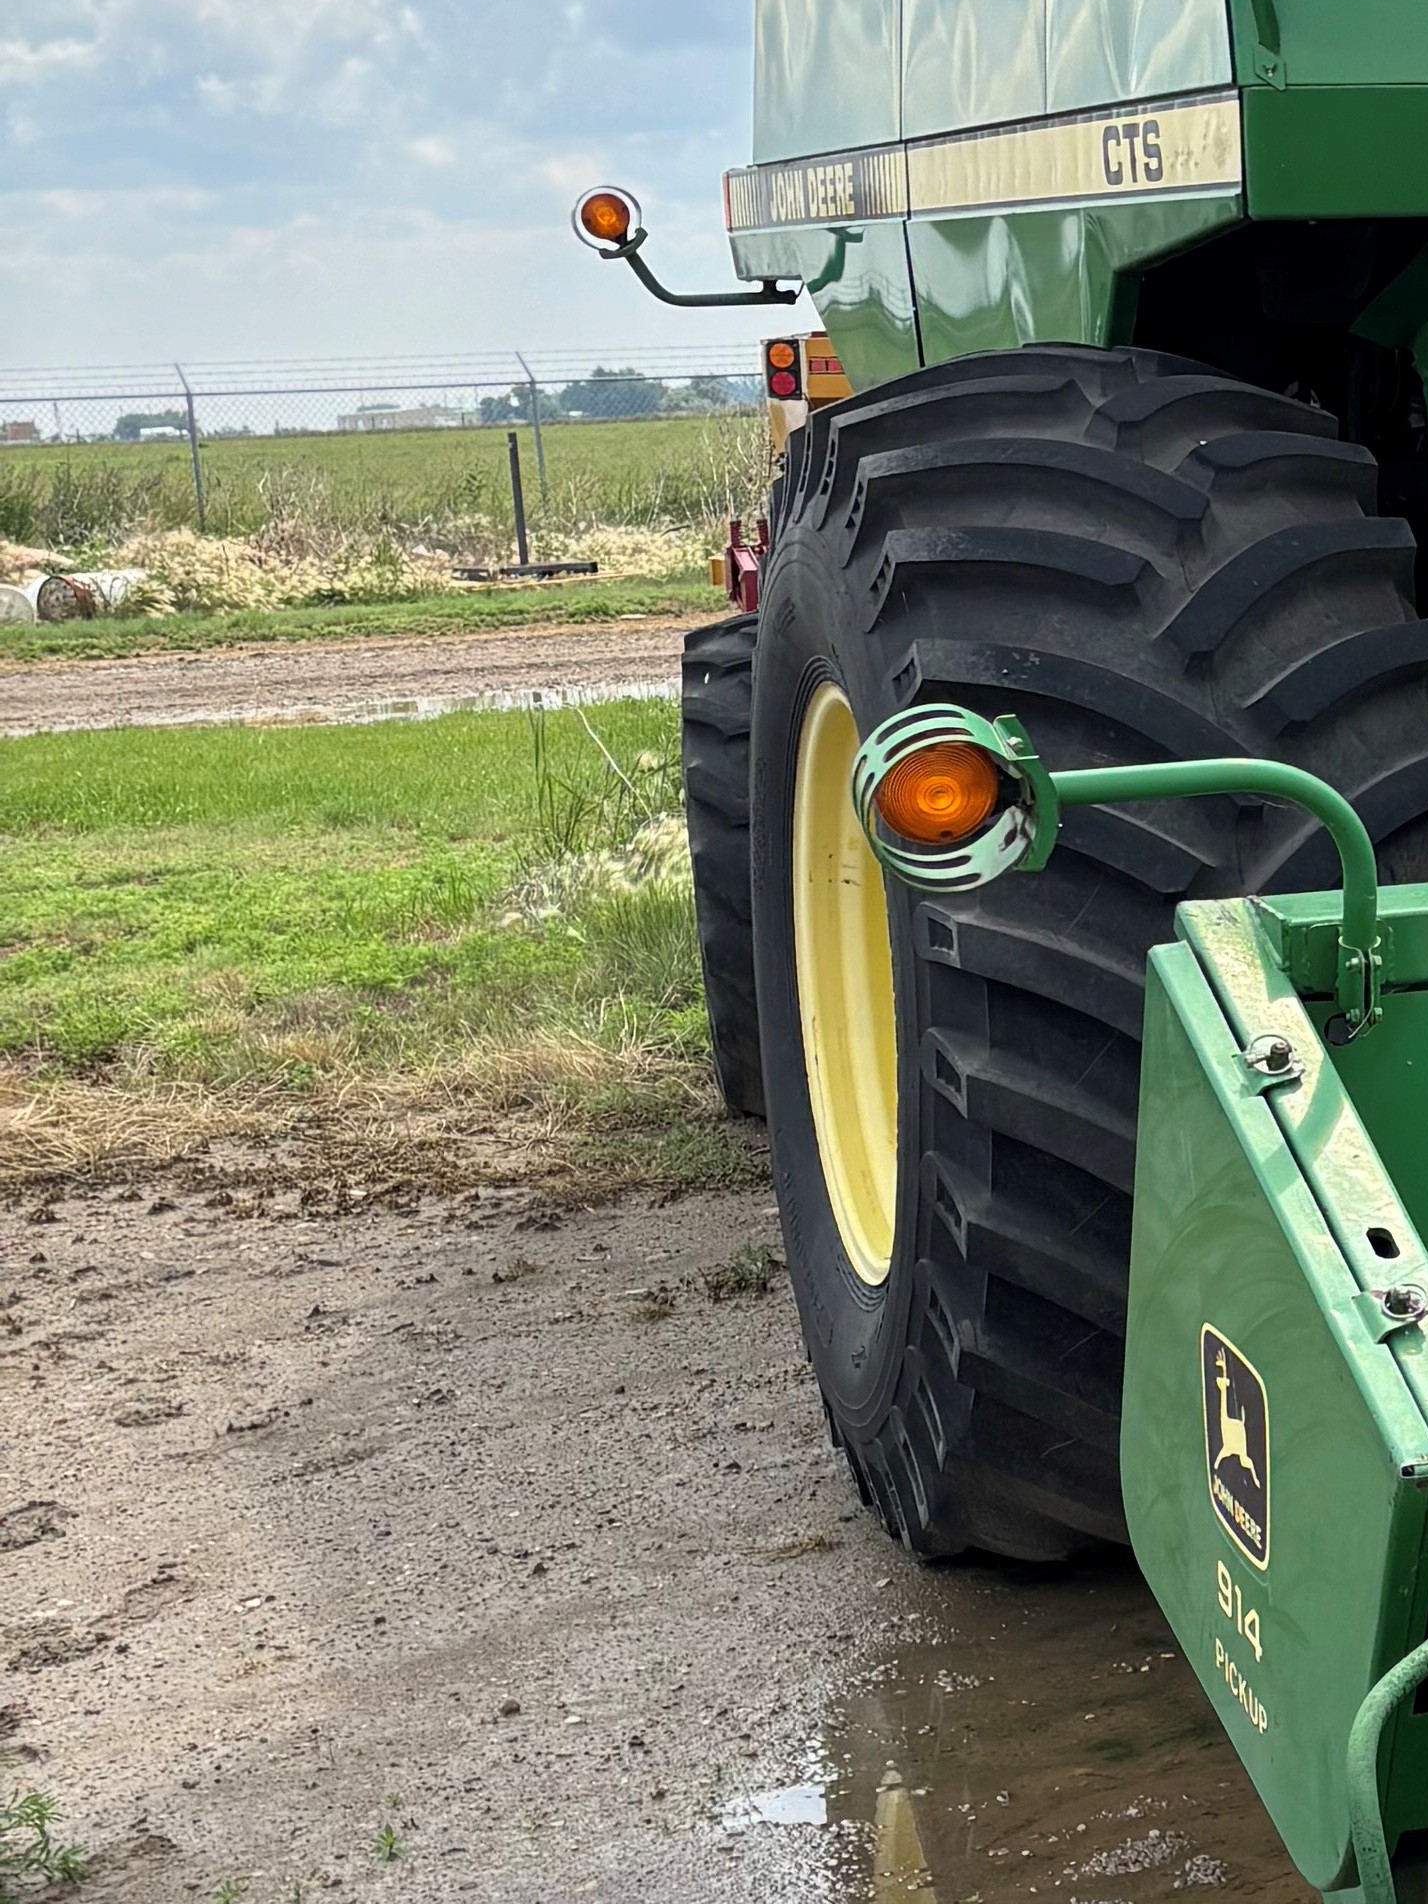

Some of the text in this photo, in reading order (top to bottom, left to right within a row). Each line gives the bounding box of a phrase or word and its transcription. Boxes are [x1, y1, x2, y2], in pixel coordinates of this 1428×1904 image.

[1102, 119, 1164, 186] CTS
[769, 162, 856, 223] JOHN DEERE
[1212, 1473, 1263, 1550] JOHN DEERE
[1216, 1559, 1264, 1665] 914
[1215, 1637, 1269, 1736] PICKUP
